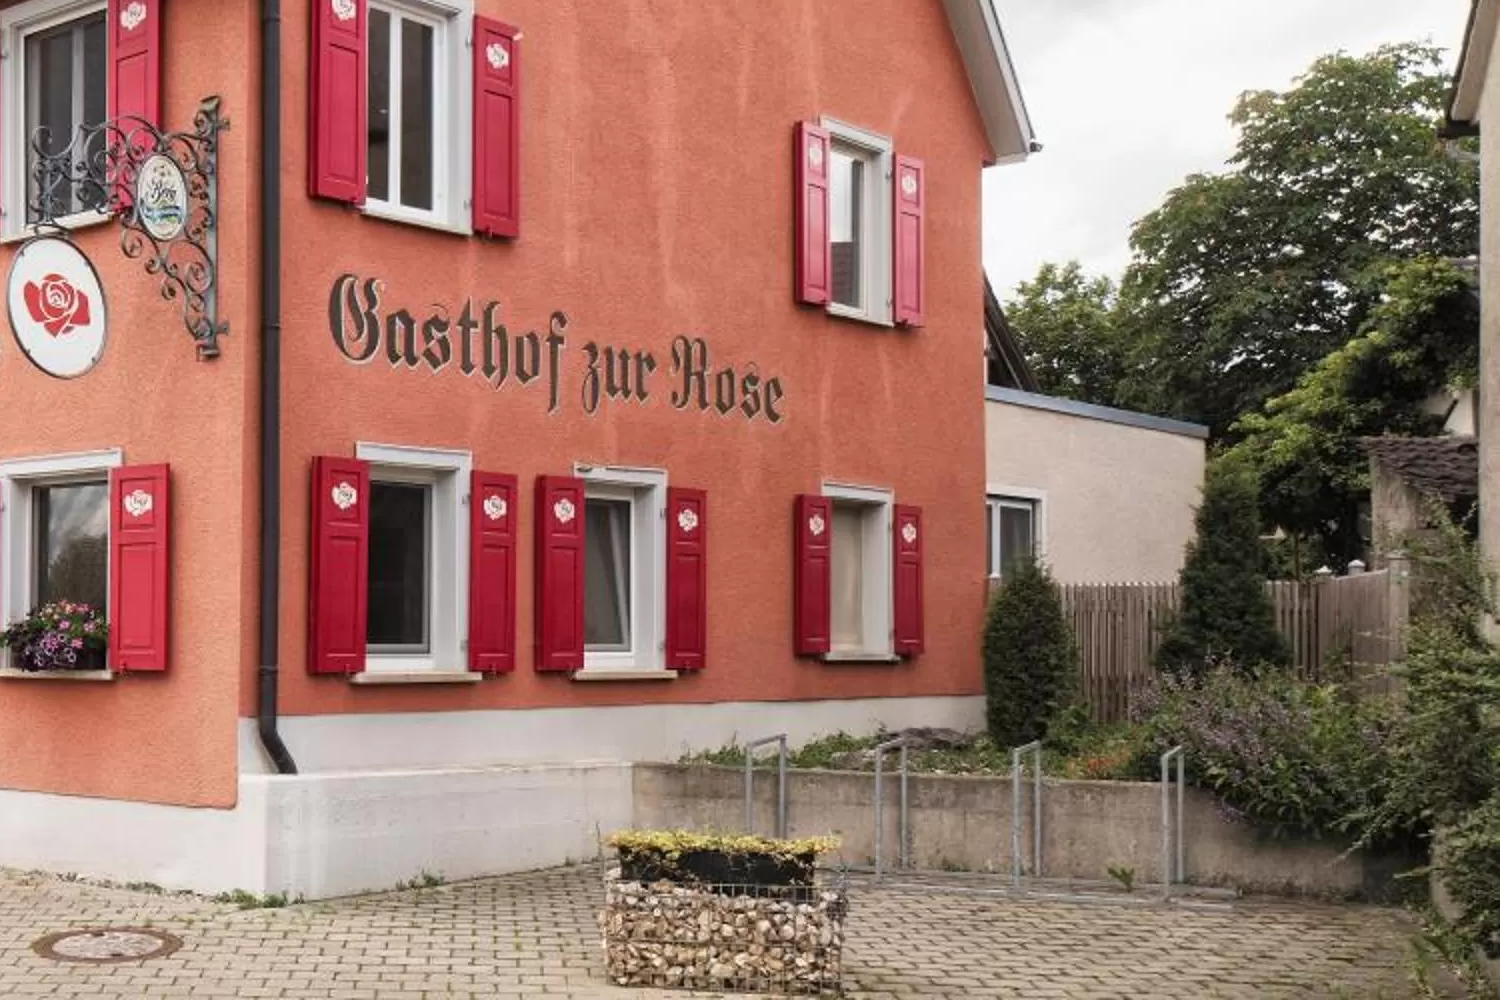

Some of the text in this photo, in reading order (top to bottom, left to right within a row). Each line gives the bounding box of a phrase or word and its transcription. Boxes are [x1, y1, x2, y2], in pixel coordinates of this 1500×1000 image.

[326, 273, 785, 424] Gasthof zur Rose
